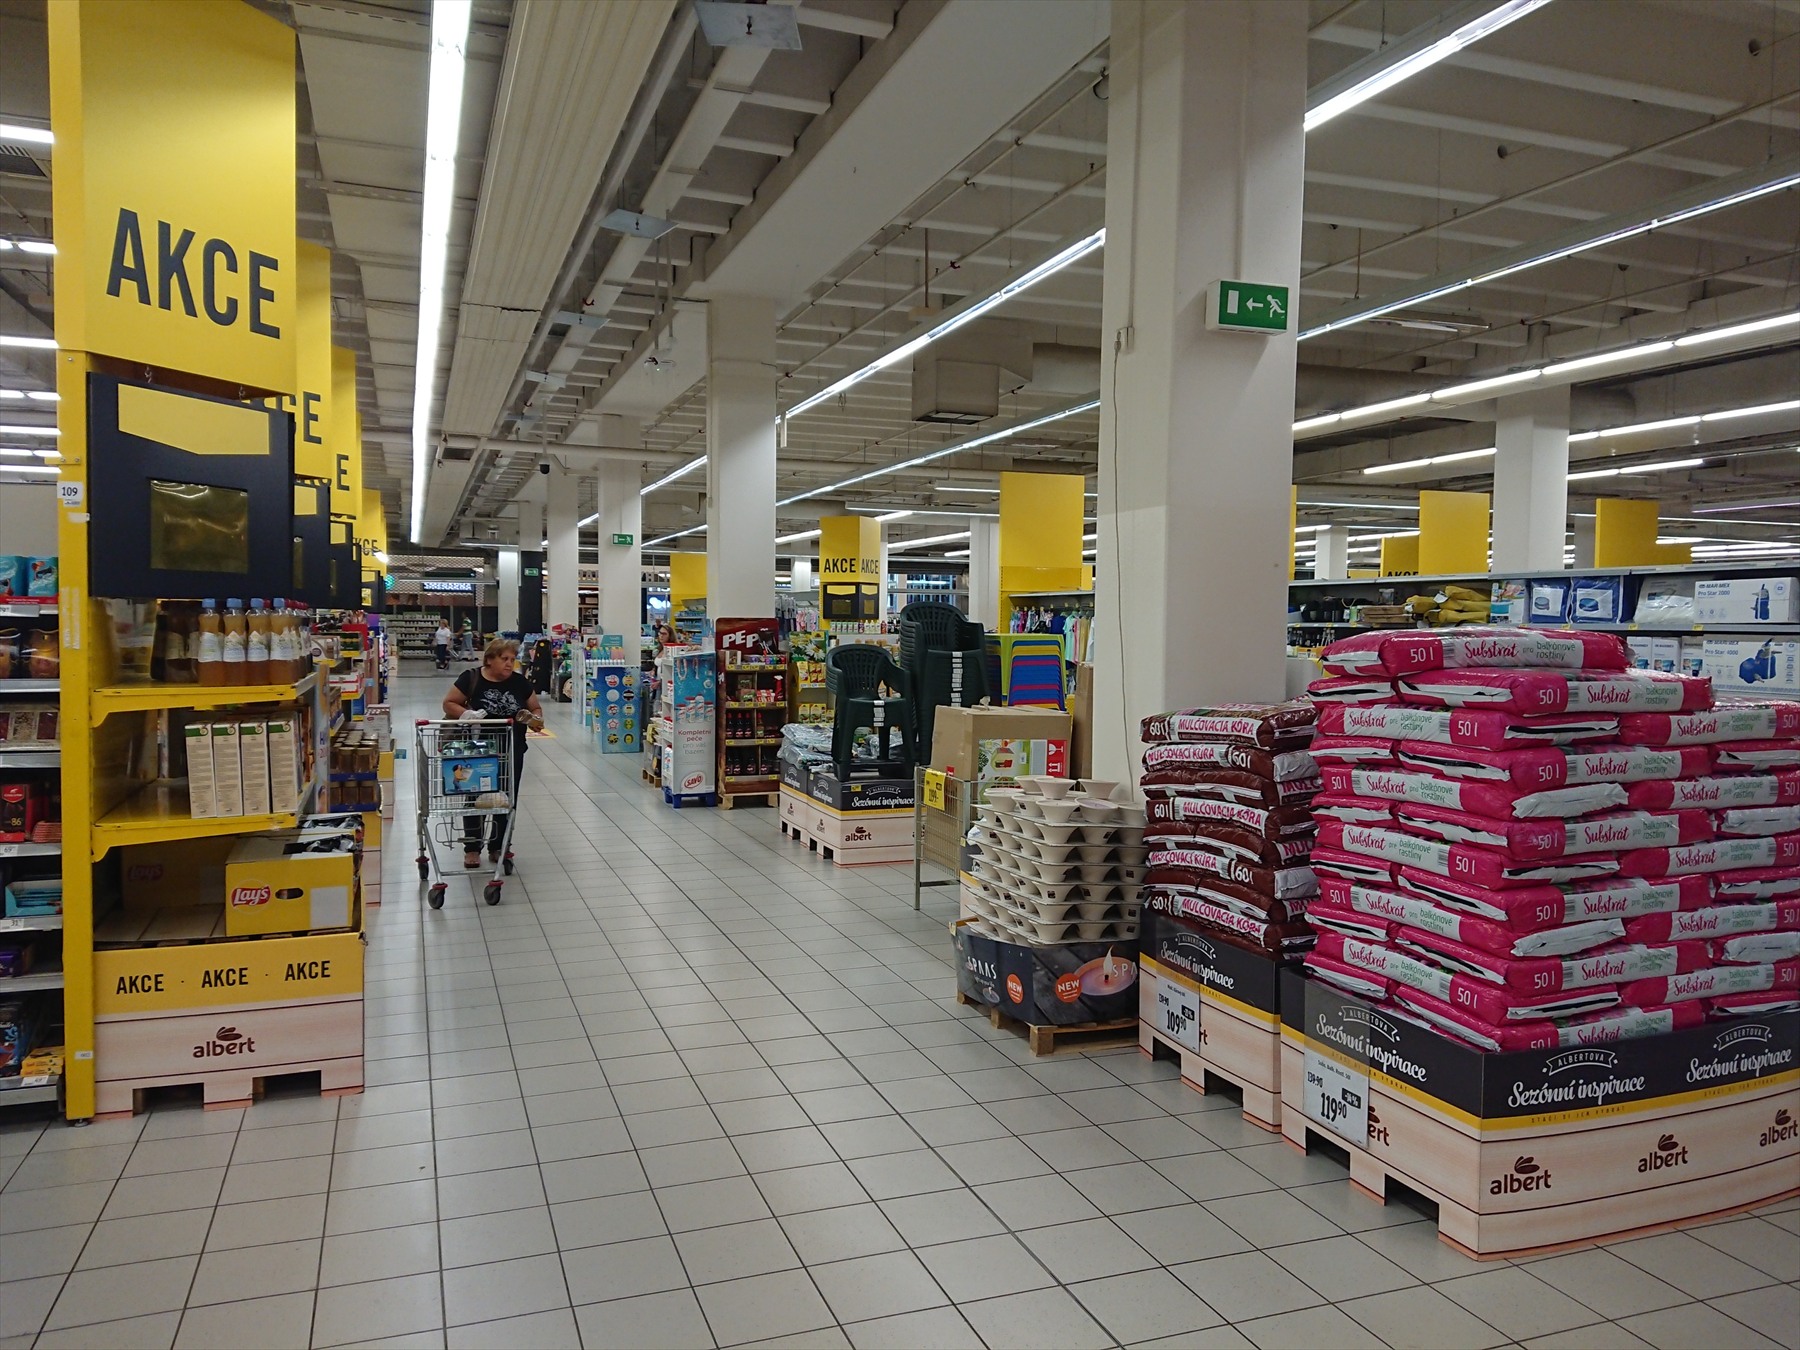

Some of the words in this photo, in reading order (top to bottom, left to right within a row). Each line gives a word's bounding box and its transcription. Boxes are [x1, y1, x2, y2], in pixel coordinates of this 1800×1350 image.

[106, 207, 281, 340] AKCE
[62, 486, 78, 496] 109
[824, 558, 857, 574] AKCE
[861, 558, 879, 575] AKCE
[1410, 648, 1427, 663] 50
[1465, 640, 1519, 659] Substrát
[1539, 690, 1554, 705] 50
[1588, 684, 1632, 704] Substrát
[1178, 718, 1229, 733] MULČOVACIA
[1349, 710, 1388, 728] Substrát
[1458, 721, 1471, 736] 50
[1677, 718, 1719, 737] Substrát
[1538, 766, 1553, 782] 50
[1585, 757, 1630, 776] Substrát
[1331, 777, 1342, 790] 50
[1366, 775, 1407, 795] Substrát
[1681, 785, 1721, 802] Substrát
[1785, 784, 1795, 795] 50
[882, 797, 914, 808] inspirace
[1183, 801, 1235, 818] MULČOVACIA
[845, 832, 872, 842] albert
[1538, 835, 1552, 850] 50
[1584, 826, 1630, 845] Substrát
[1348, 829, 1387, 850] Substrát
[1455, 856, 1469, 872] 50
[1676, 850, 1717, 869] Substrát
[1783, 844, 1794, 856] 50
[234, 887, 269, 906] Lay's
[1330, 889, 1340, 903] 50
[1366, 893, 1407, 918] Substrát
[1420, 909, 1453, 926] balkónové
[1536, 906, 1550, 921] 50
[1584, 895, 1629, 915] Substrát
[1678, 914, 1720, 933] Substrát
[1784, 910, 1794, 923] 50
[116, 974, 164, 995] AKCE
[201, 967, 249, 989] AKCE
[284, 960, 331, 982] AKCE
[968, 956, 997, 980] SPAAS
[1192, 958, 1235, 990] inspirace
[1349, 944, 1388, 969] Substrát
[1401, 960, 1433, 980] balkónové
[1457, 988, 1471, 1005] 50
[1534, 973, 1549, 989] 50
[1582, 960, 1625, 981] Substrát
[1008, 981, 1023, 993] NEW
[1058, 981, 1080, 993] NEW
[1674, 976, 1716, 996] Substrát
[1780, 969, 1792, 982] 50
[1350, 1010, 1388, 1032] ALBERTOVA
[1726, 1028, 1762, 1042] ALBERTOVA
[192, 1037, 256, 1059] albert
[1316, 1014, 1364, 1053] Sezónní
[1366, 1039, 1427, 1082] inspirace
[1558, 1053, 1605, 1068] ALBERTOVA
[1686, 1052, 1738, 1083] Sezónní
[1740, 1048, 1793, 1077] inspirace
[1508, 1080, 1575, 1108] Sezónní
[1578, 1075, 1646, 1106] inspirace
[1368, 1124, 1390, 1147] ert
[1760, 1120, 1799, 1147] albert
[1638, 1146, 1689, 1173] albert
[1490, 1169, 1552, 1195] albert
